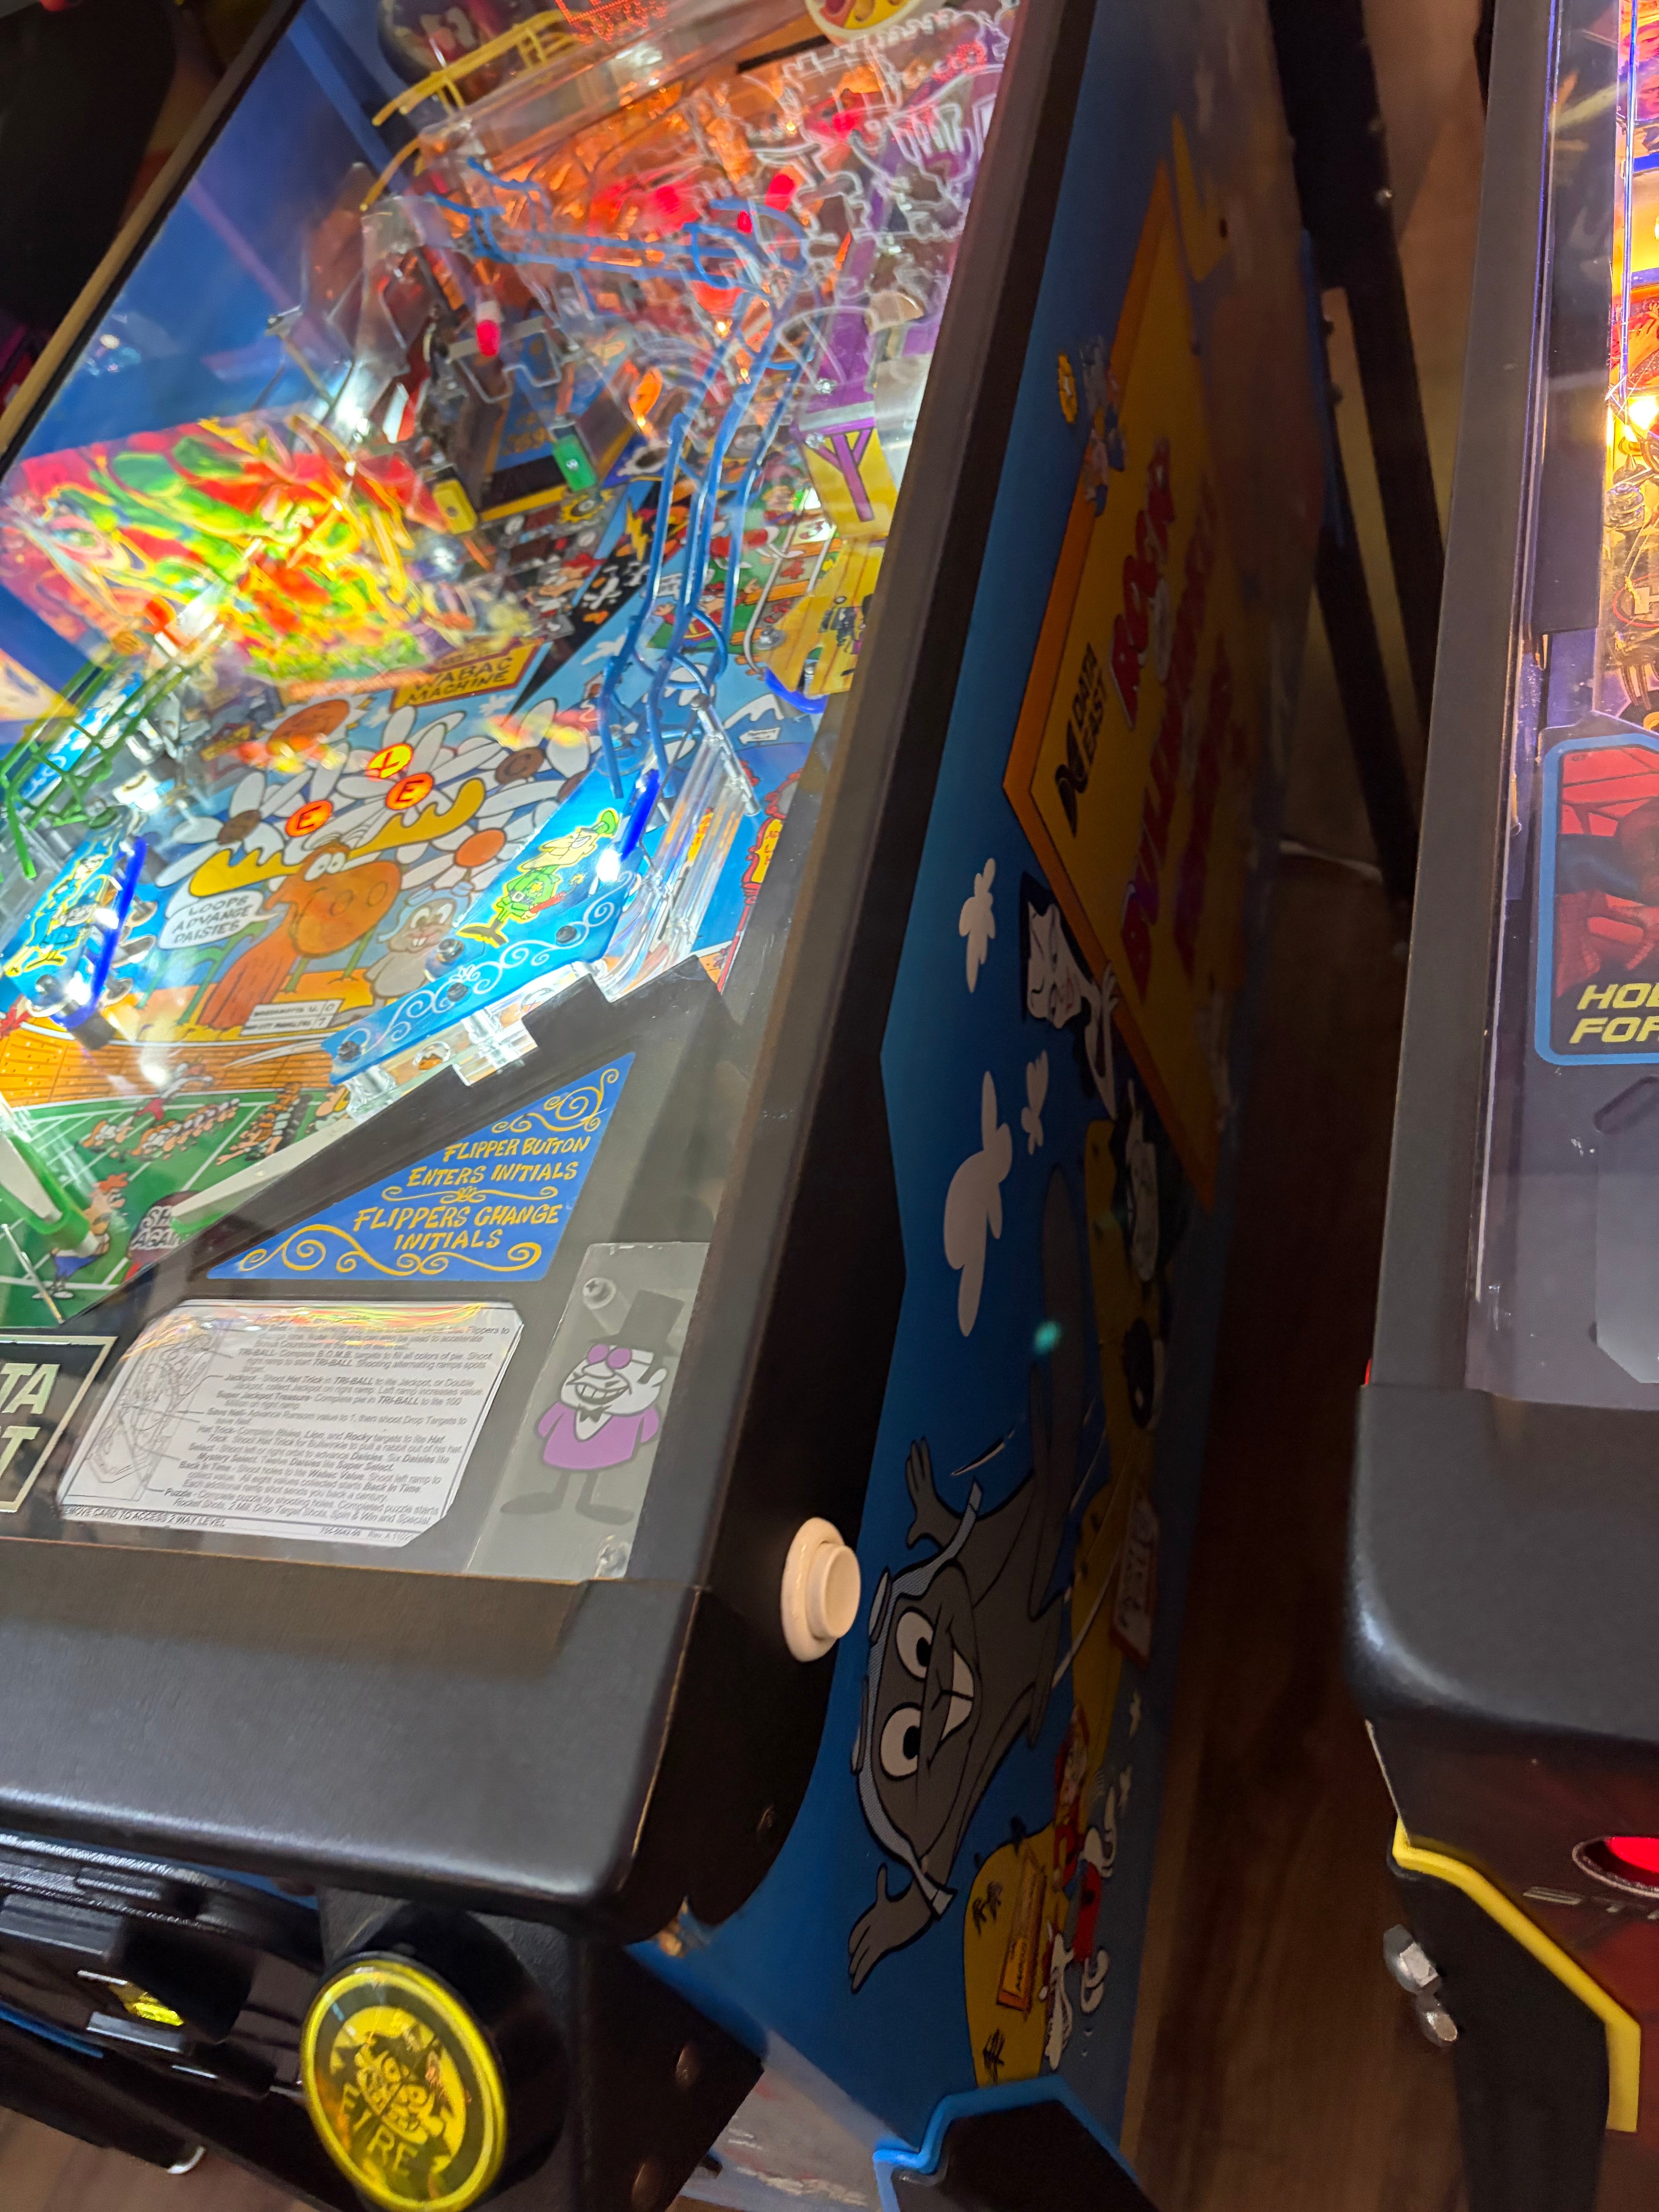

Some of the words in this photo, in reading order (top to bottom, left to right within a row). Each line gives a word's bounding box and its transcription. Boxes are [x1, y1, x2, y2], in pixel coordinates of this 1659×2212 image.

[442, 1138, 520, 1162] FLIPPER
[521, 1135, 591, 1156] BUTTON
[407, 1165, 487, 1187] ENTERS
[490, 1161, 579, 1182] INITIALS
[353, 1206, 471, 1231] FLIPPERS
[474, 1204, 563, 1227] CHANGE
[394, 1228, 503, 1252] INITIALS
[378, 1396, 421, 1405] TRI-BALL
